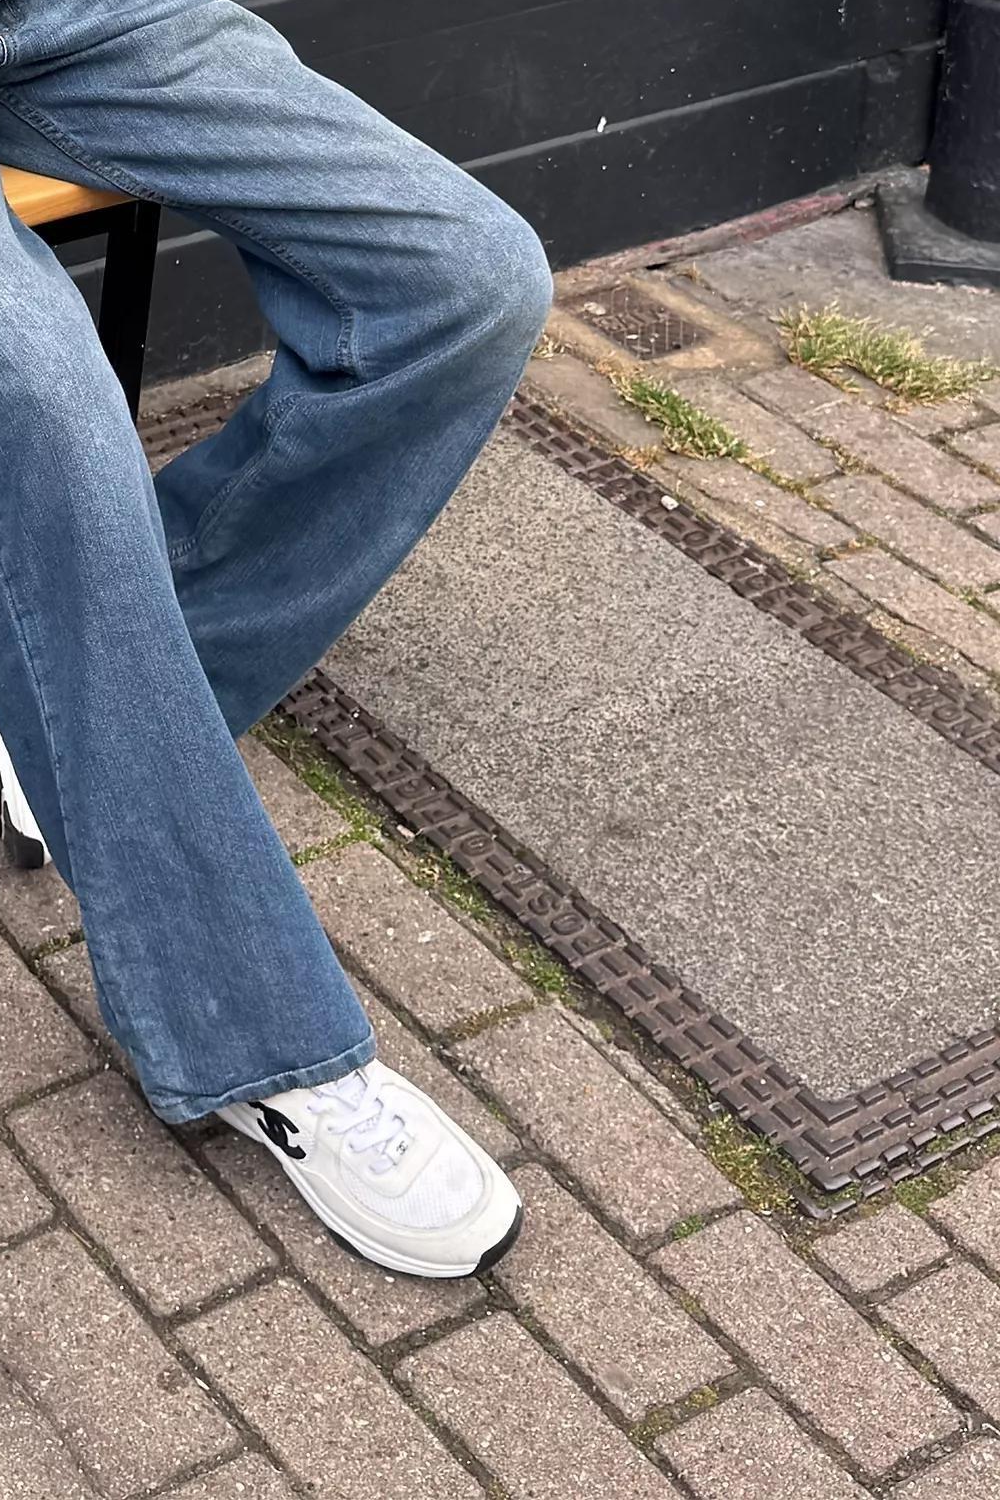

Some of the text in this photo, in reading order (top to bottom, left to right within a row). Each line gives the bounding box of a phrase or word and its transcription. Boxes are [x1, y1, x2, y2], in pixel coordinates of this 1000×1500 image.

[587, 460, 672, 518] POST
[682, 530, 794, 606] OFFICE
[376, 761, 496, 856] OFFICE
[503, 875, 616, 957] POST
